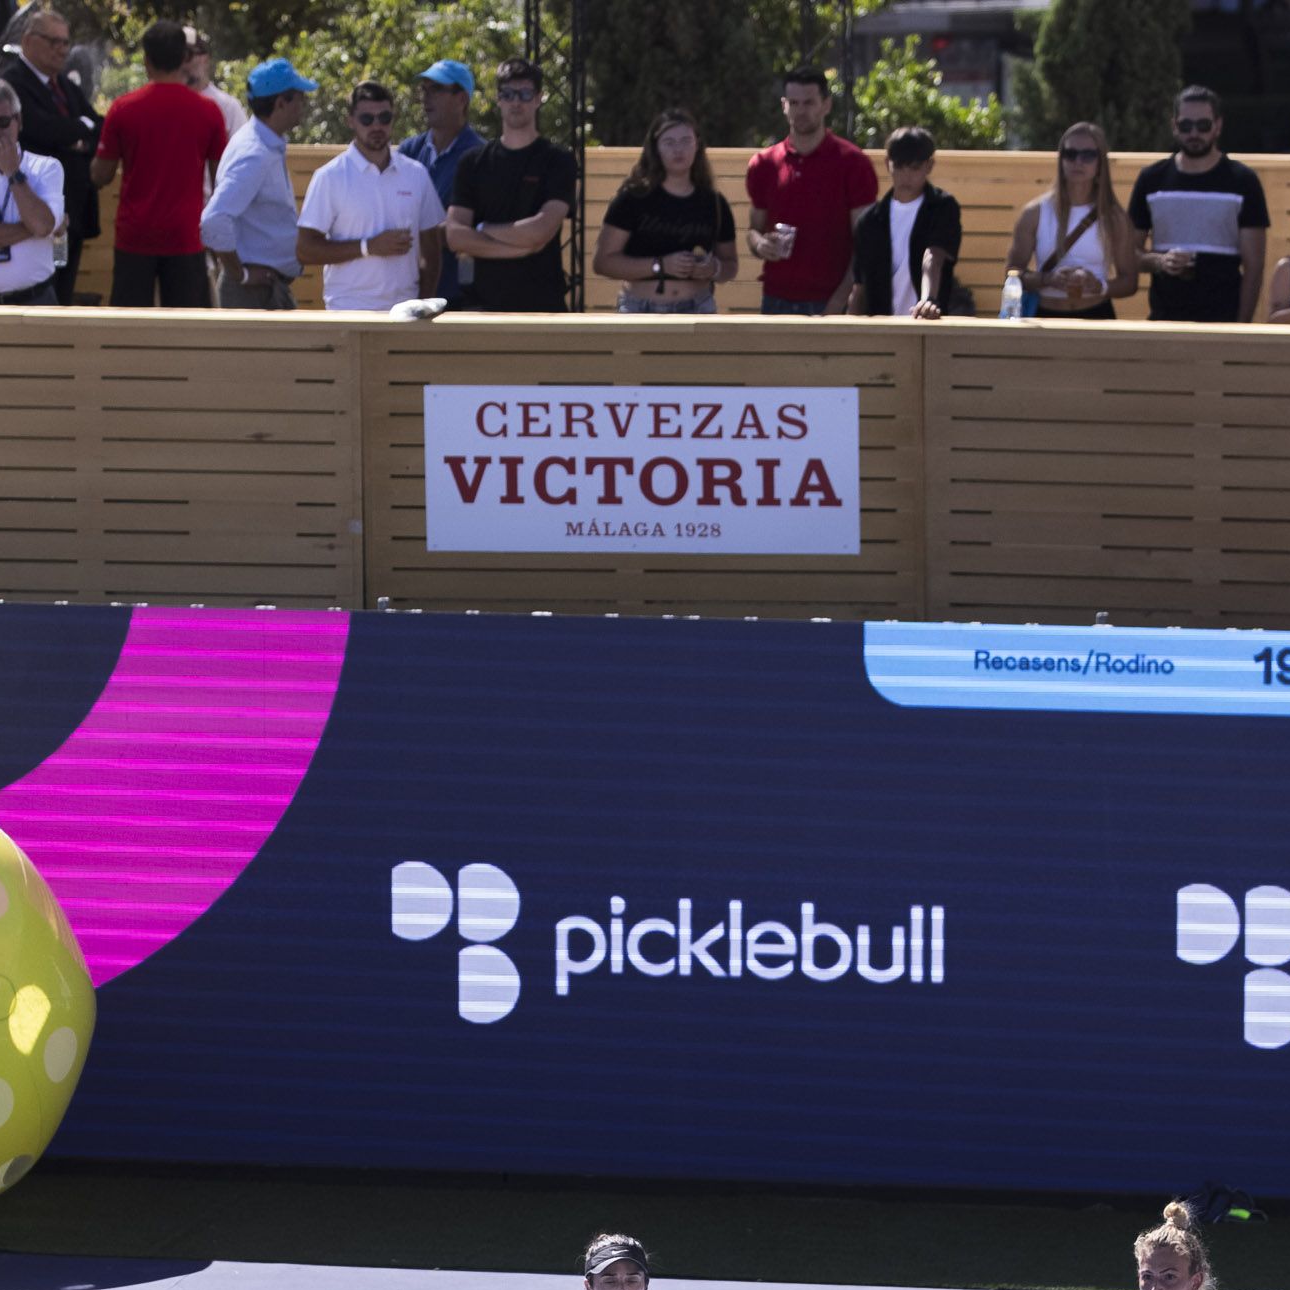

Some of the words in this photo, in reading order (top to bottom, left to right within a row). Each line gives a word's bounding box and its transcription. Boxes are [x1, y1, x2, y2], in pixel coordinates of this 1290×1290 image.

[475, 401, 809, 440] CERVEZAS
[443, 455, 843, 507] VICTORIA
[565, 517, 666, 538] MÁLAGA
[674, 522, 722, 538] 1928
[974, 649, 1176, 676] Recasens/Rodino
[555, 895, 945, 996] picklebull
